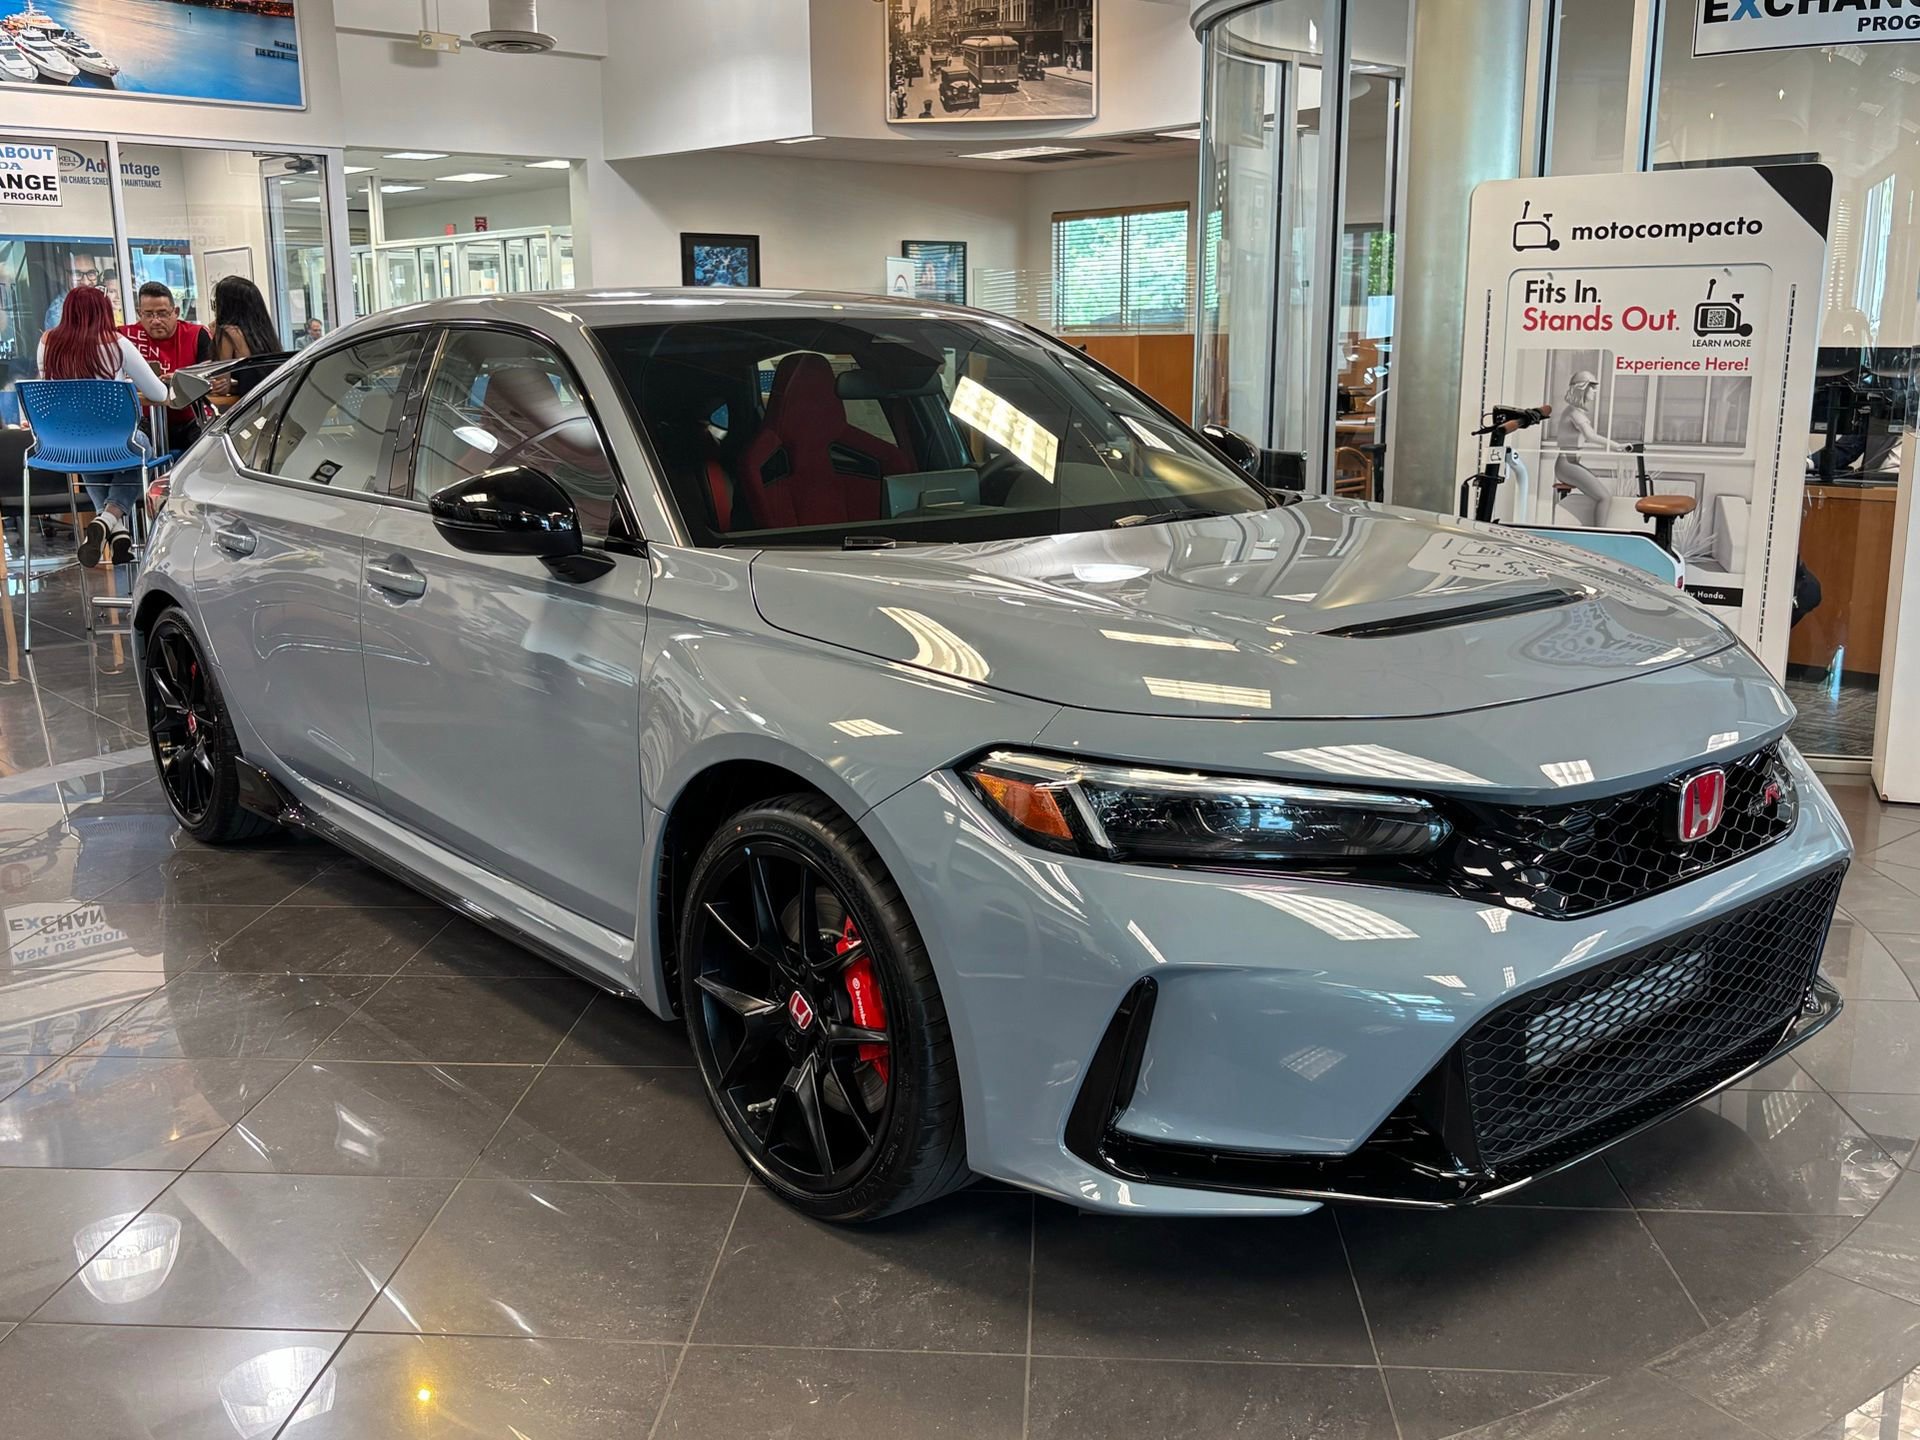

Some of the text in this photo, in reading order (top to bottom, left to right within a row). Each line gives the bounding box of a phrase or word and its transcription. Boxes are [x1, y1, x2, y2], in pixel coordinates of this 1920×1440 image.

[69, 175, 91, 185] CHARGE
[125, 179, 162, 188] MAINTENANCE
[3, 192, 58, 202] PROGRAM
[1571, 215, 1763, 243] motocompacto
[1525, 279, 1602, 304] Fits In.
[1522, 306, 1680, 332] Stands Out.
[1692, 338, 1752, 348] LEARN MORE
[1616, 356, 1749, 374] Experience Here!
[1698, 590, 1726, 600] Honda.
